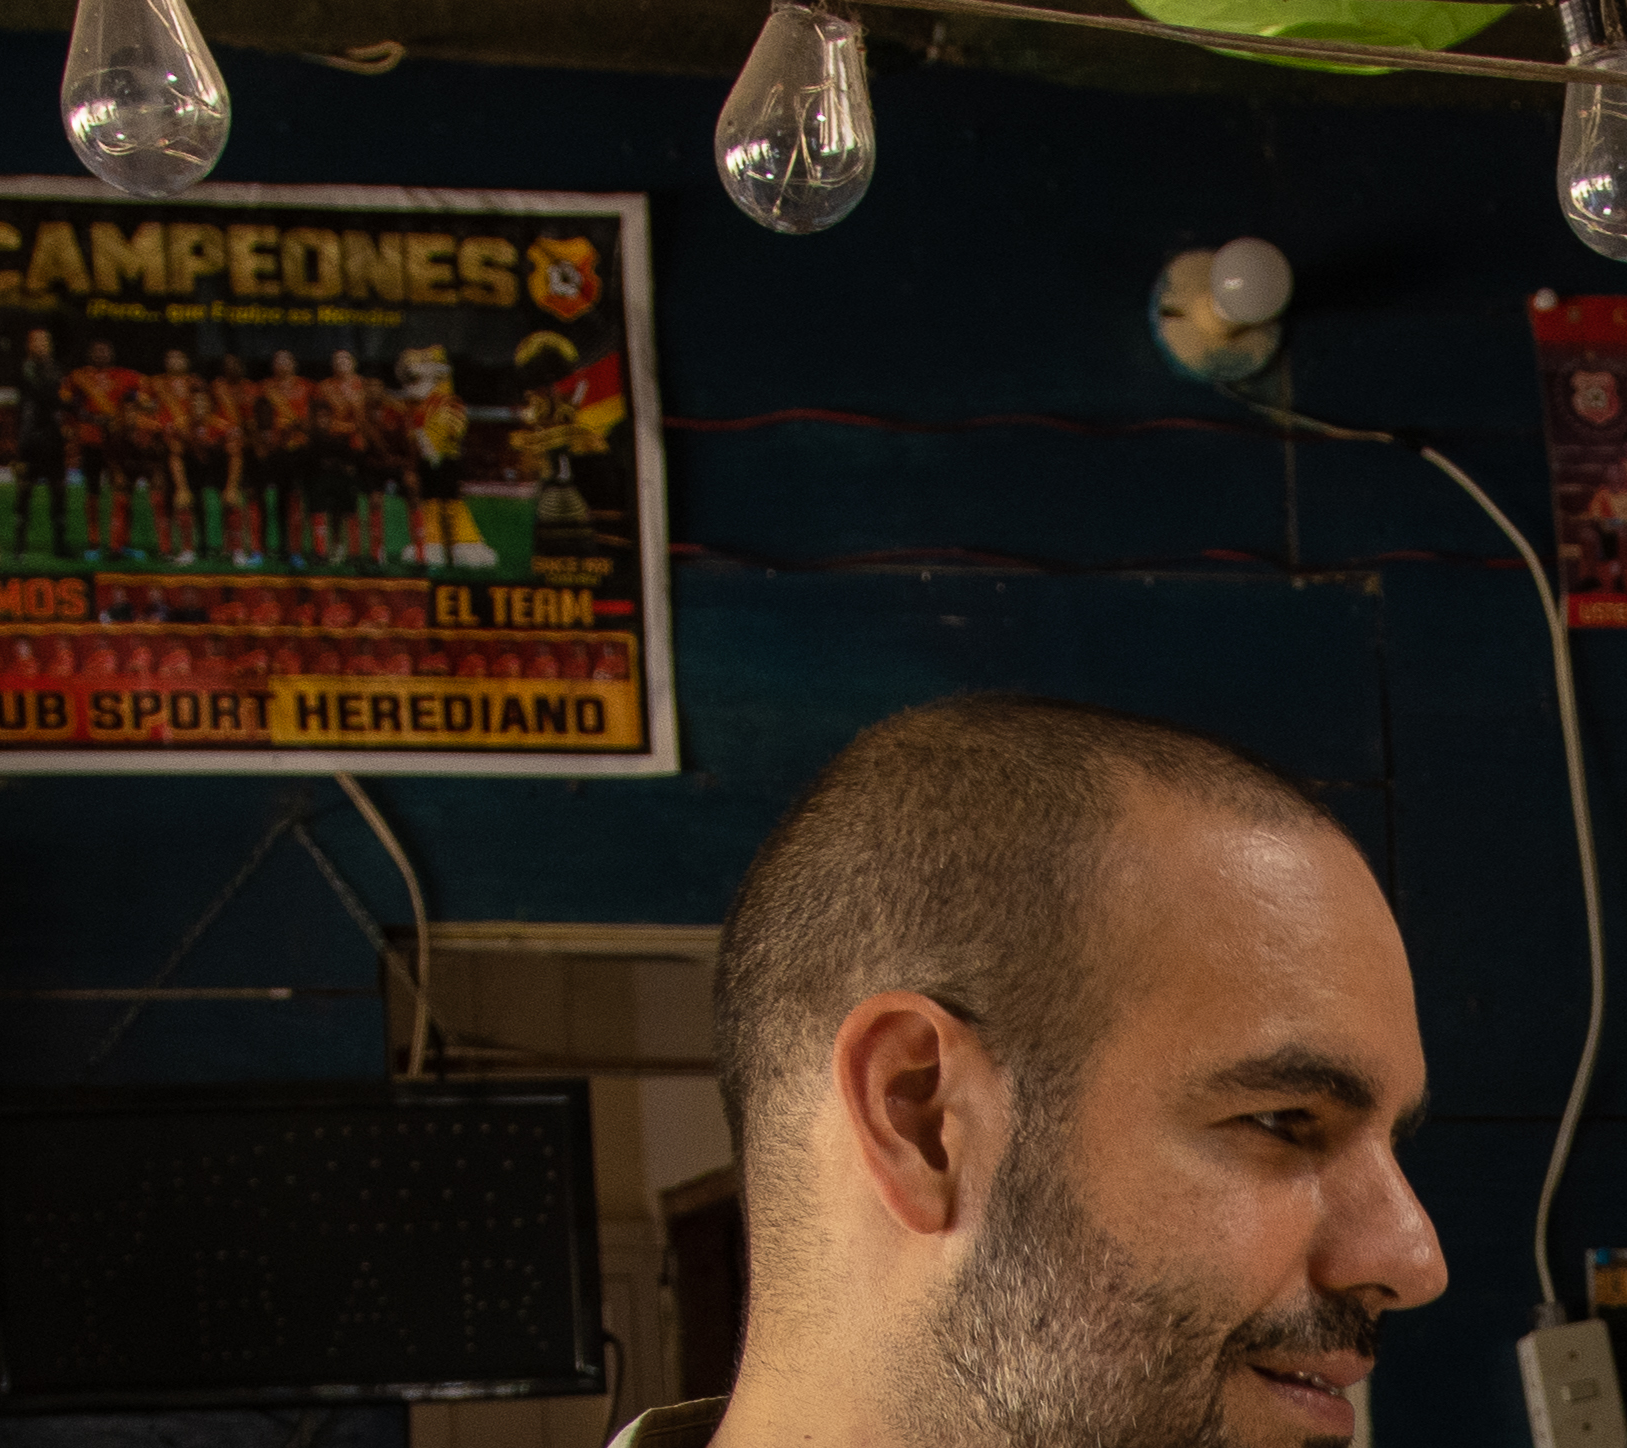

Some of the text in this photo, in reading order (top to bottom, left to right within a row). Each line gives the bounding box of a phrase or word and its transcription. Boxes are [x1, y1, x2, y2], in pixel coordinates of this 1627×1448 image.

[435, 585, 595, 629] EL TEAM
[88, 691, 274, 736] SPORT
[298, 692, 607, 736] HEREDIANO
